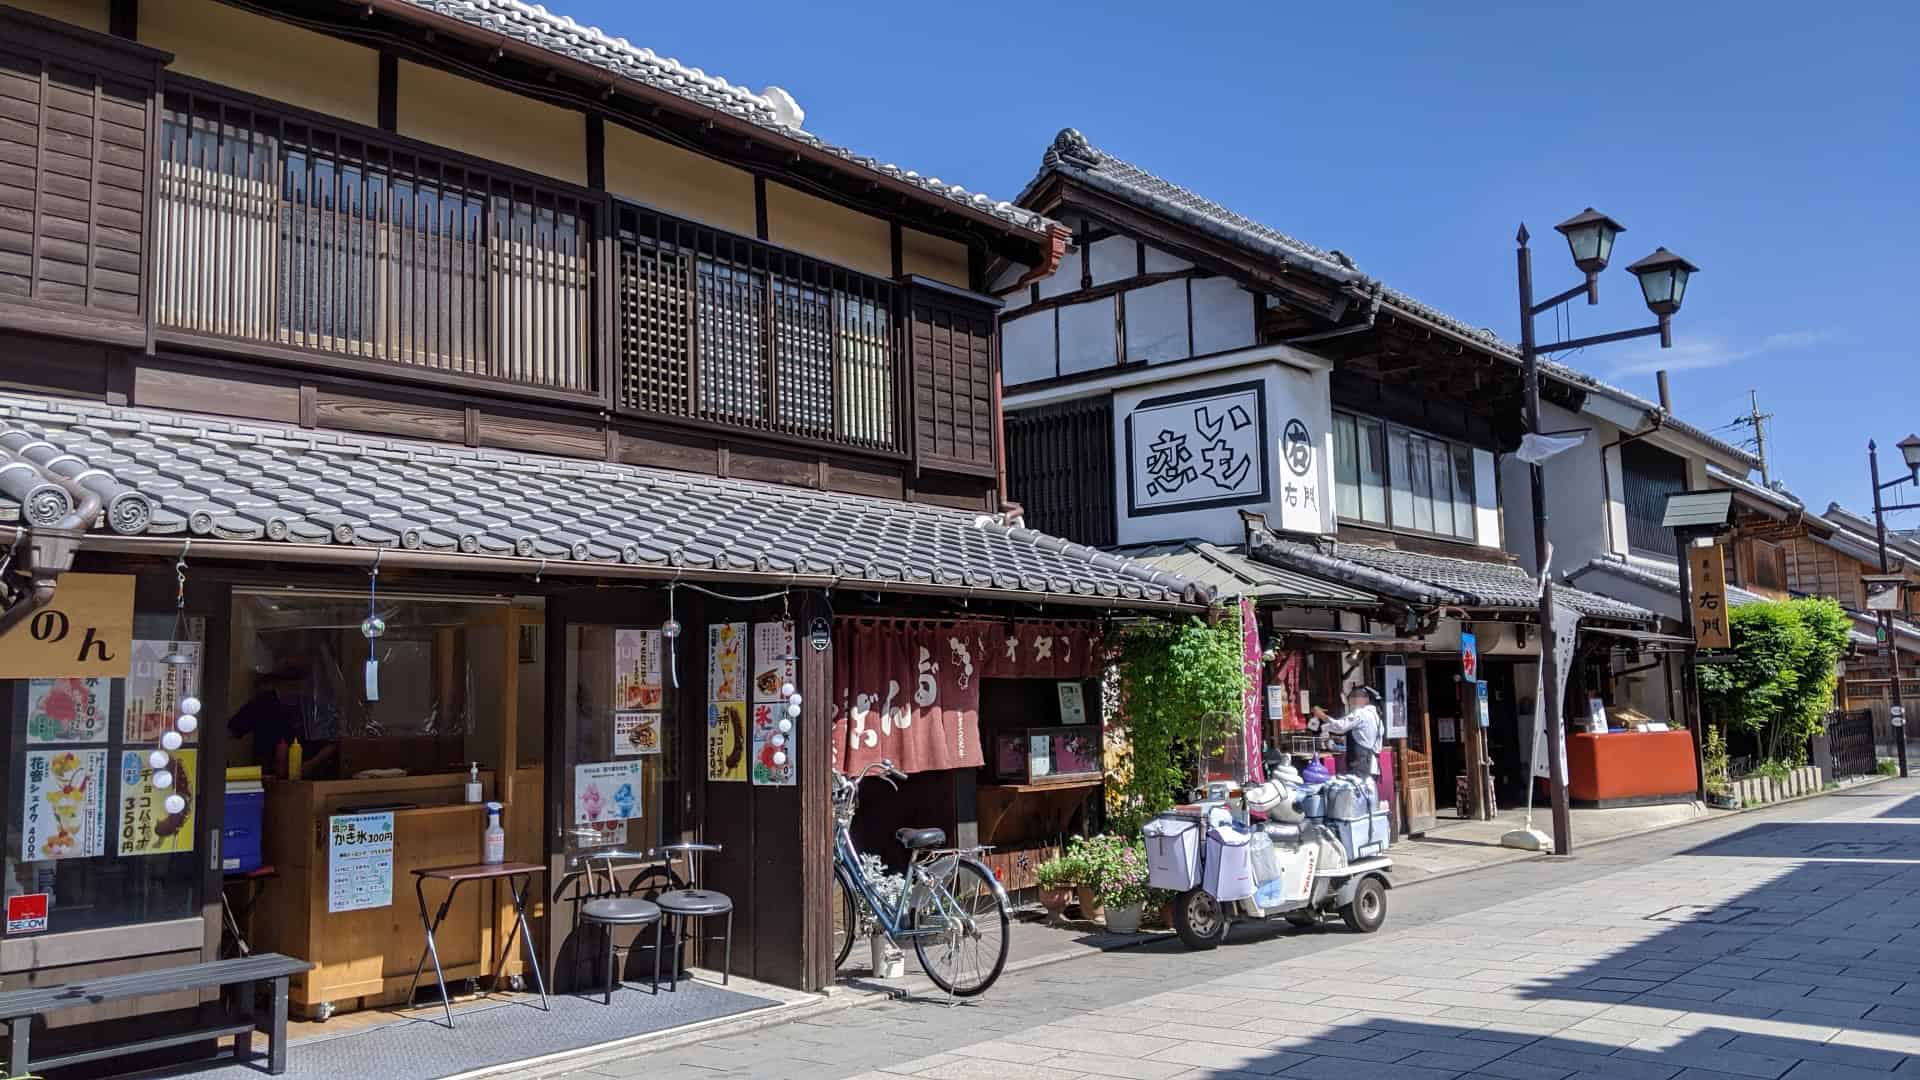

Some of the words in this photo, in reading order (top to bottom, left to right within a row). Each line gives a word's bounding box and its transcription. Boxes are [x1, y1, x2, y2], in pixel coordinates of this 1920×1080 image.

[1284, 481, 1318, 512] 右門
[31, 609, 115, 662] のん
[1699, 592, 1722, 636] 右門
[756, 704, 773, 728] 氷
[851, 646, 939, 750] だんご
[122, 798, 135, 853] 350円
[136, 769, 153, 849] チョコバナナ
[10, 919, 44, 930] SECOM
